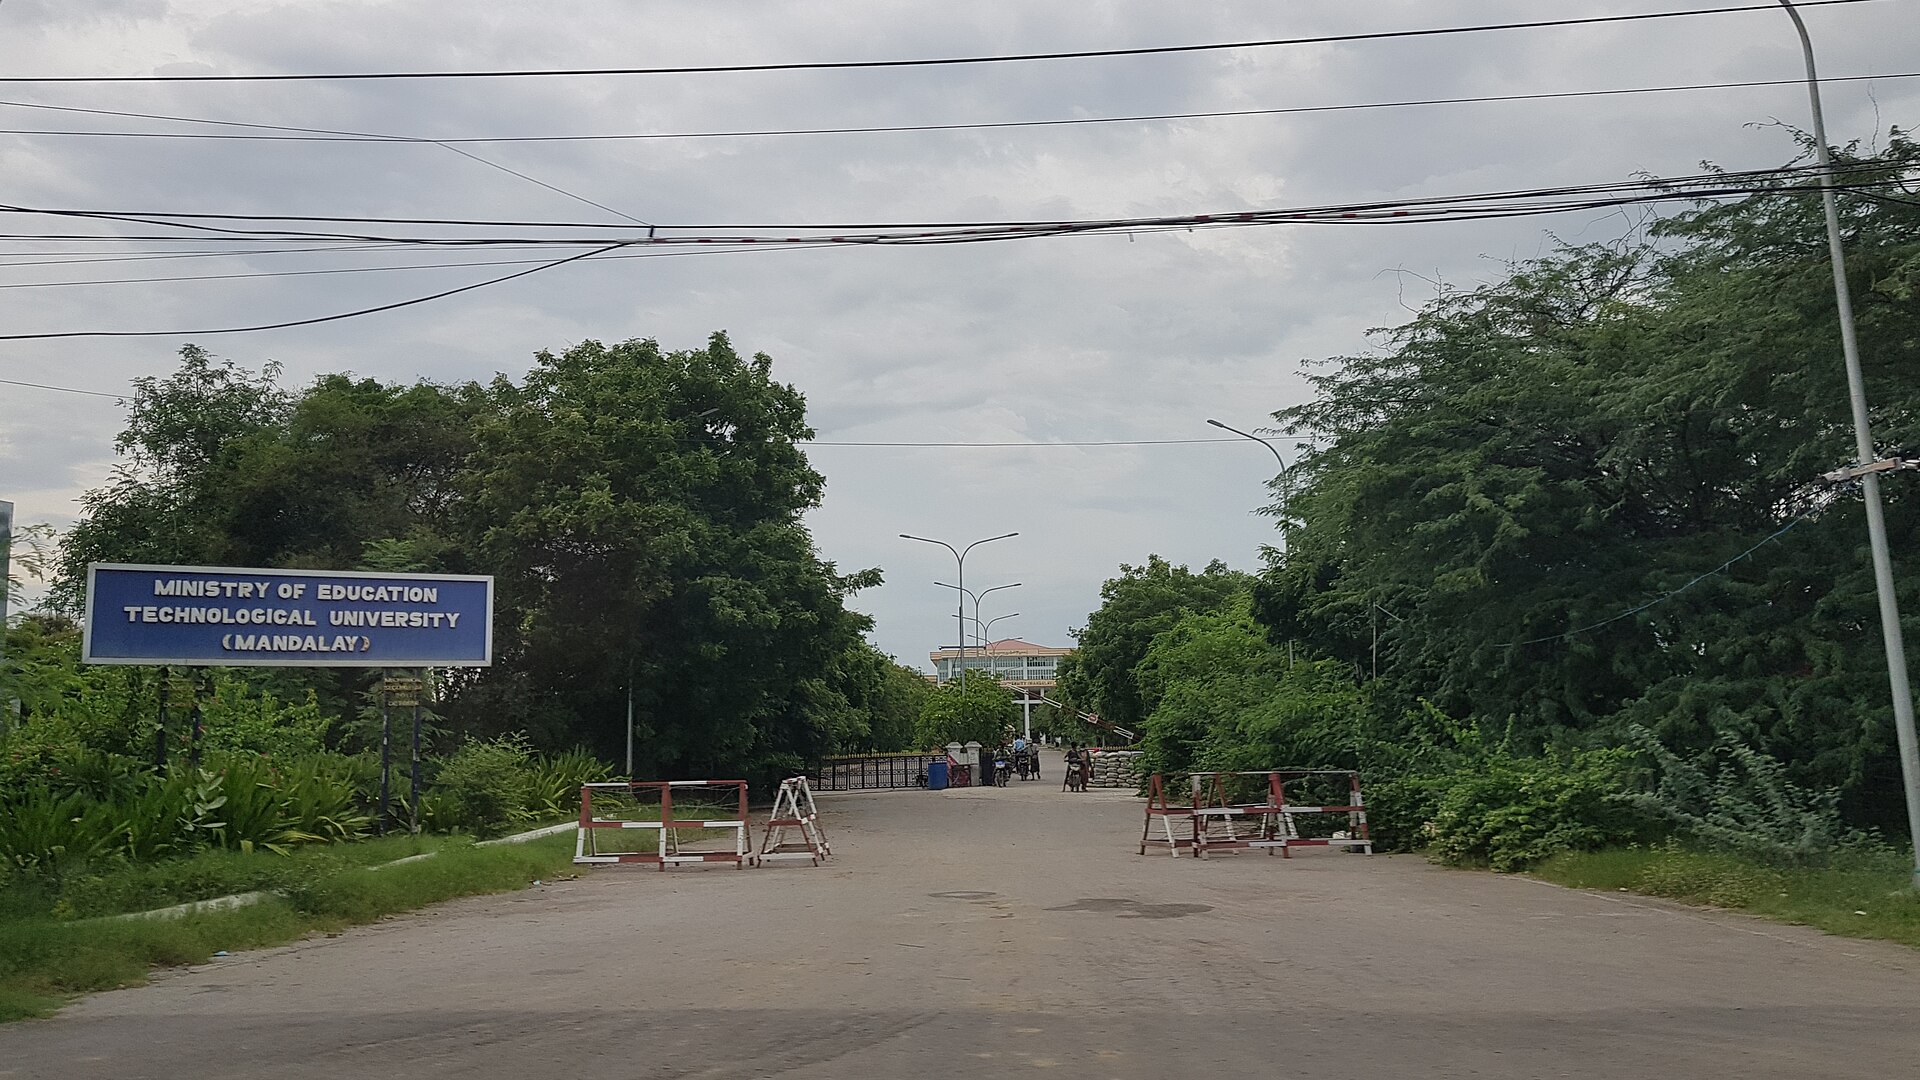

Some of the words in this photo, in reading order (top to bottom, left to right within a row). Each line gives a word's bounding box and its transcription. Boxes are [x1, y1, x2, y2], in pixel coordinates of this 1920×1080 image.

[154, 579, 270, 599] MINISTRY
[277, 583, 306, 599] OF
[317, 584, 438, 603] EDUCATION
[123, 606, 316, 626] TECHNOLOGICAL
[329, 610, 460, 628] UNIVERSITY
[222, 633, 371, 652] (MANDALAY)
